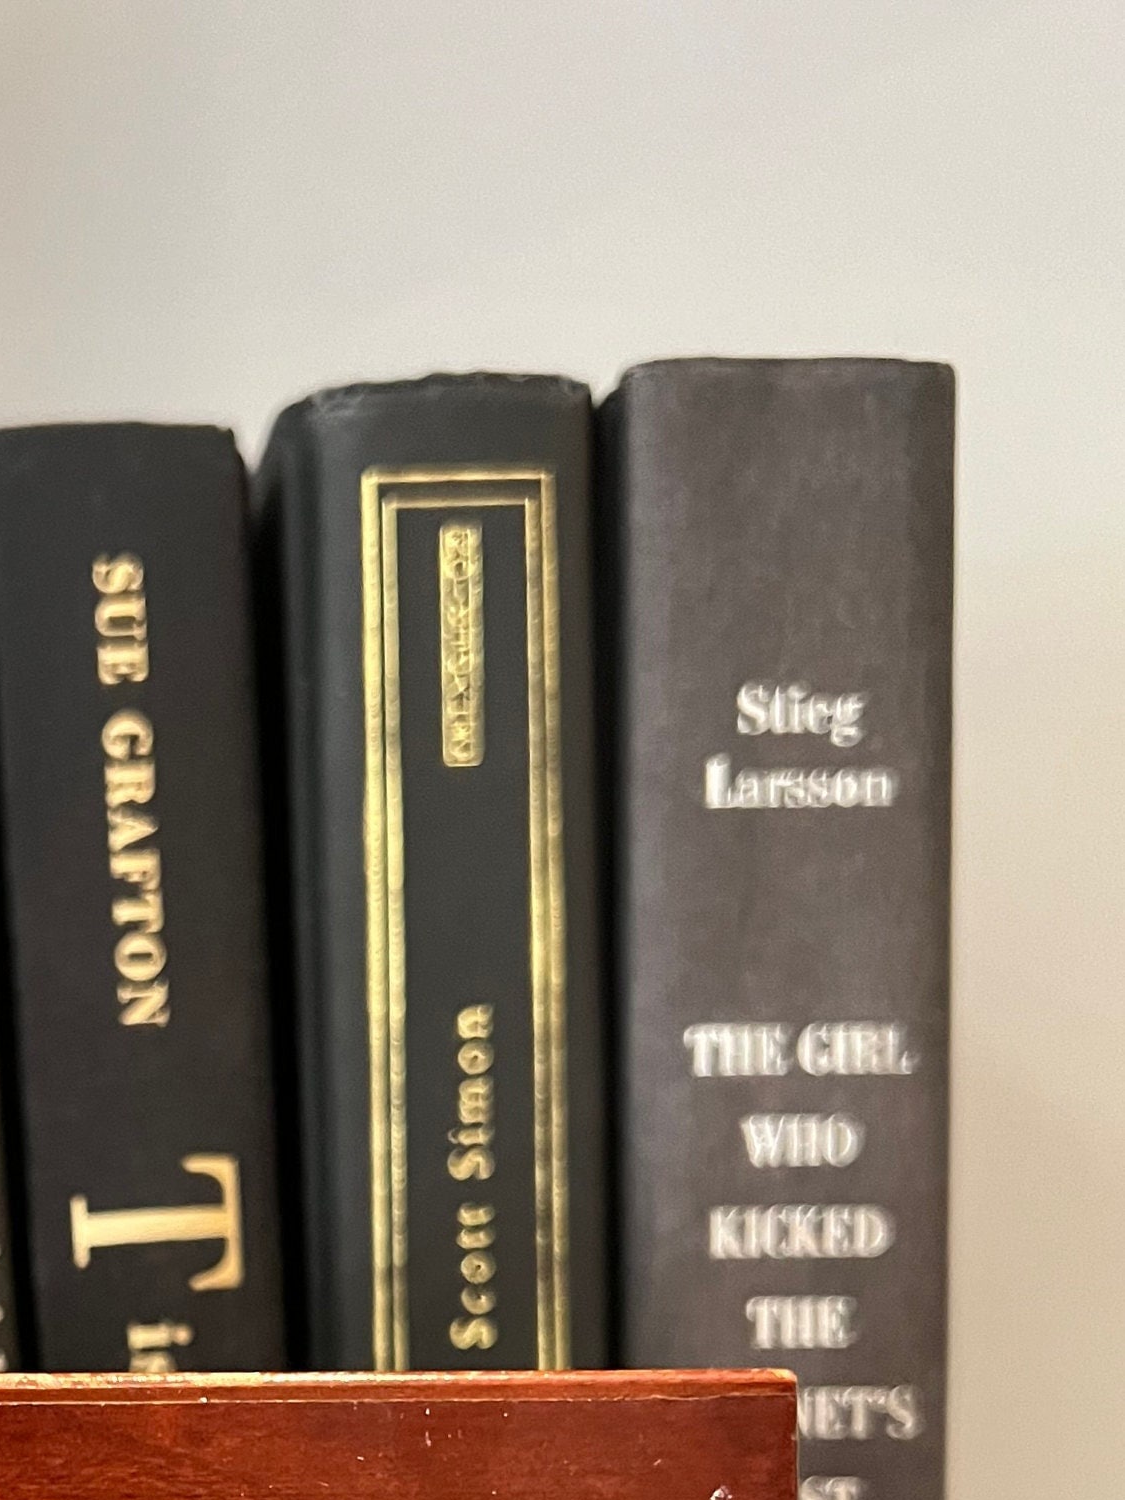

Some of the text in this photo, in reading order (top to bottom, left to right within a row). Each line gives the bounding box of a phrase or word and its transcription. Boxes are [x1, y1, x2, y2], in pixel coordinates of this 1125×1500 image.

[735, 683, 865, 749] Stieg
[91, 556, 170, 1027] SUE GRAFTON
[703, 754, 896, 811] Larsson
[681, 1021, 913, 1079] THE GIRL
[739, 1113, 861, 1169] WHO
[446, 1004, 497, 1351] Scott Simon
[69, 1154, 243, 1291] T
[708, 1204, 891, 1260] KICKED
[744, 1295, 849, 1350] THE
